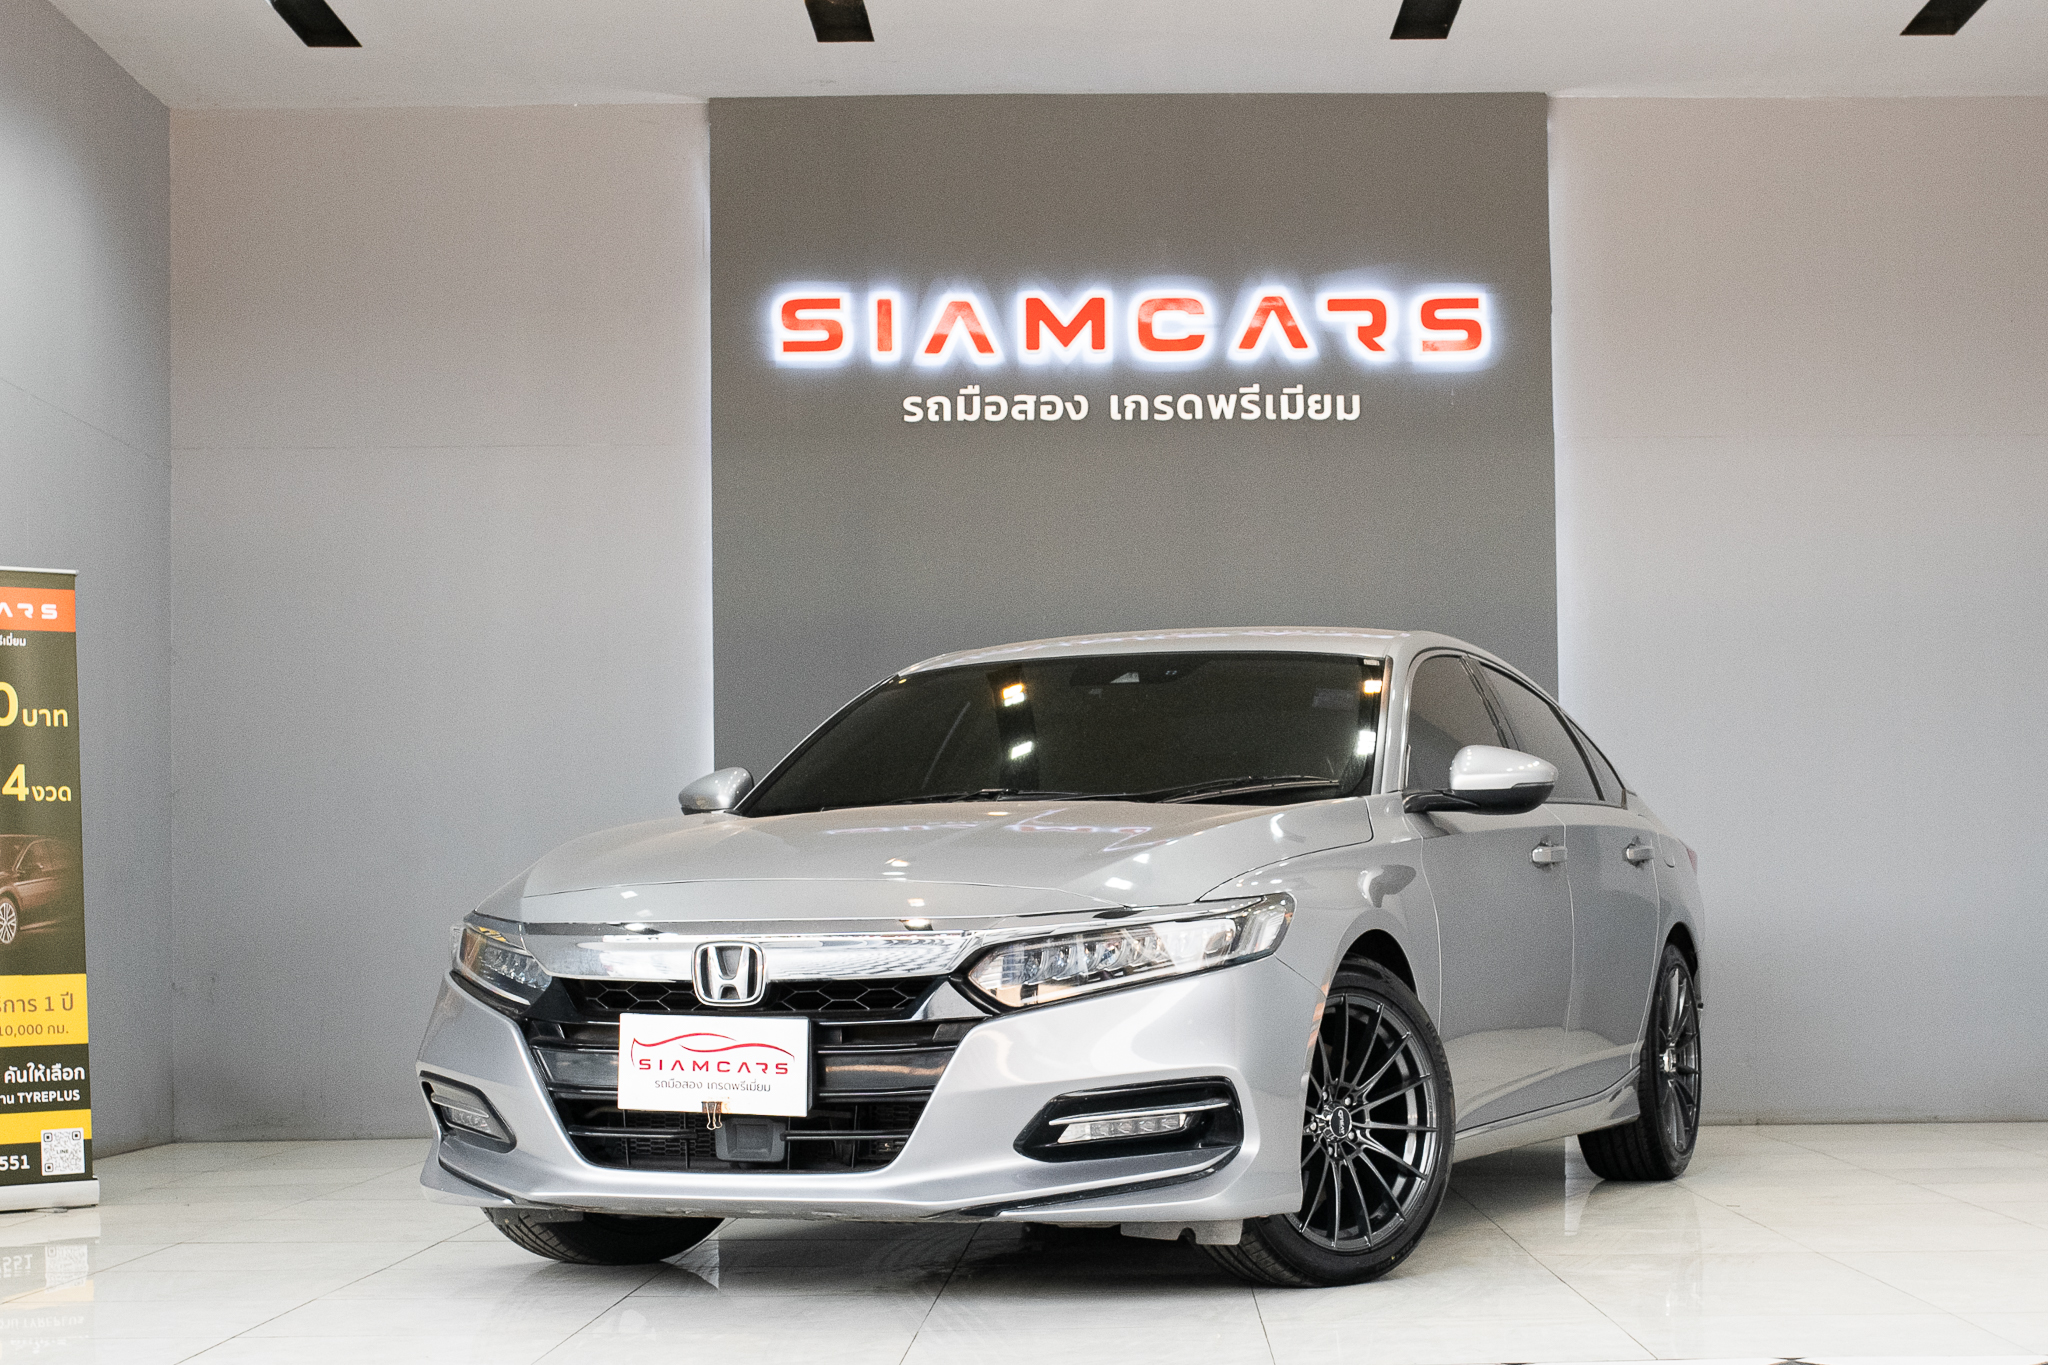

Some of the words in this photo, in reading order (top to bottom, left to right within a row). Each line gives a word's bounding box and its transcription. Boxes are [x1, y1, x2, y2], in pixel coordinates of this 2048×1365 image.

[780, 295, 1485, 355] SIAMCARS
[902, 384, 1089, 422] รถมือสอง
[1109, 383, 1361, 421] เกรดพรีเมียม
[0, 996, 37, 1013] การ
[44, 996, 55, 1012] 1
[60, 991, 74, 1011] ปี
[47, 1024, 69, 1035] กม.
[4, 1061, 86, 1084] คันให้เลือก
[638, 1058, 789, 1075] SIAMCARS
[654, 1078, 703, 1090] รถมือสอง
[17, 1089, 81, 1104] TYREPLUS
